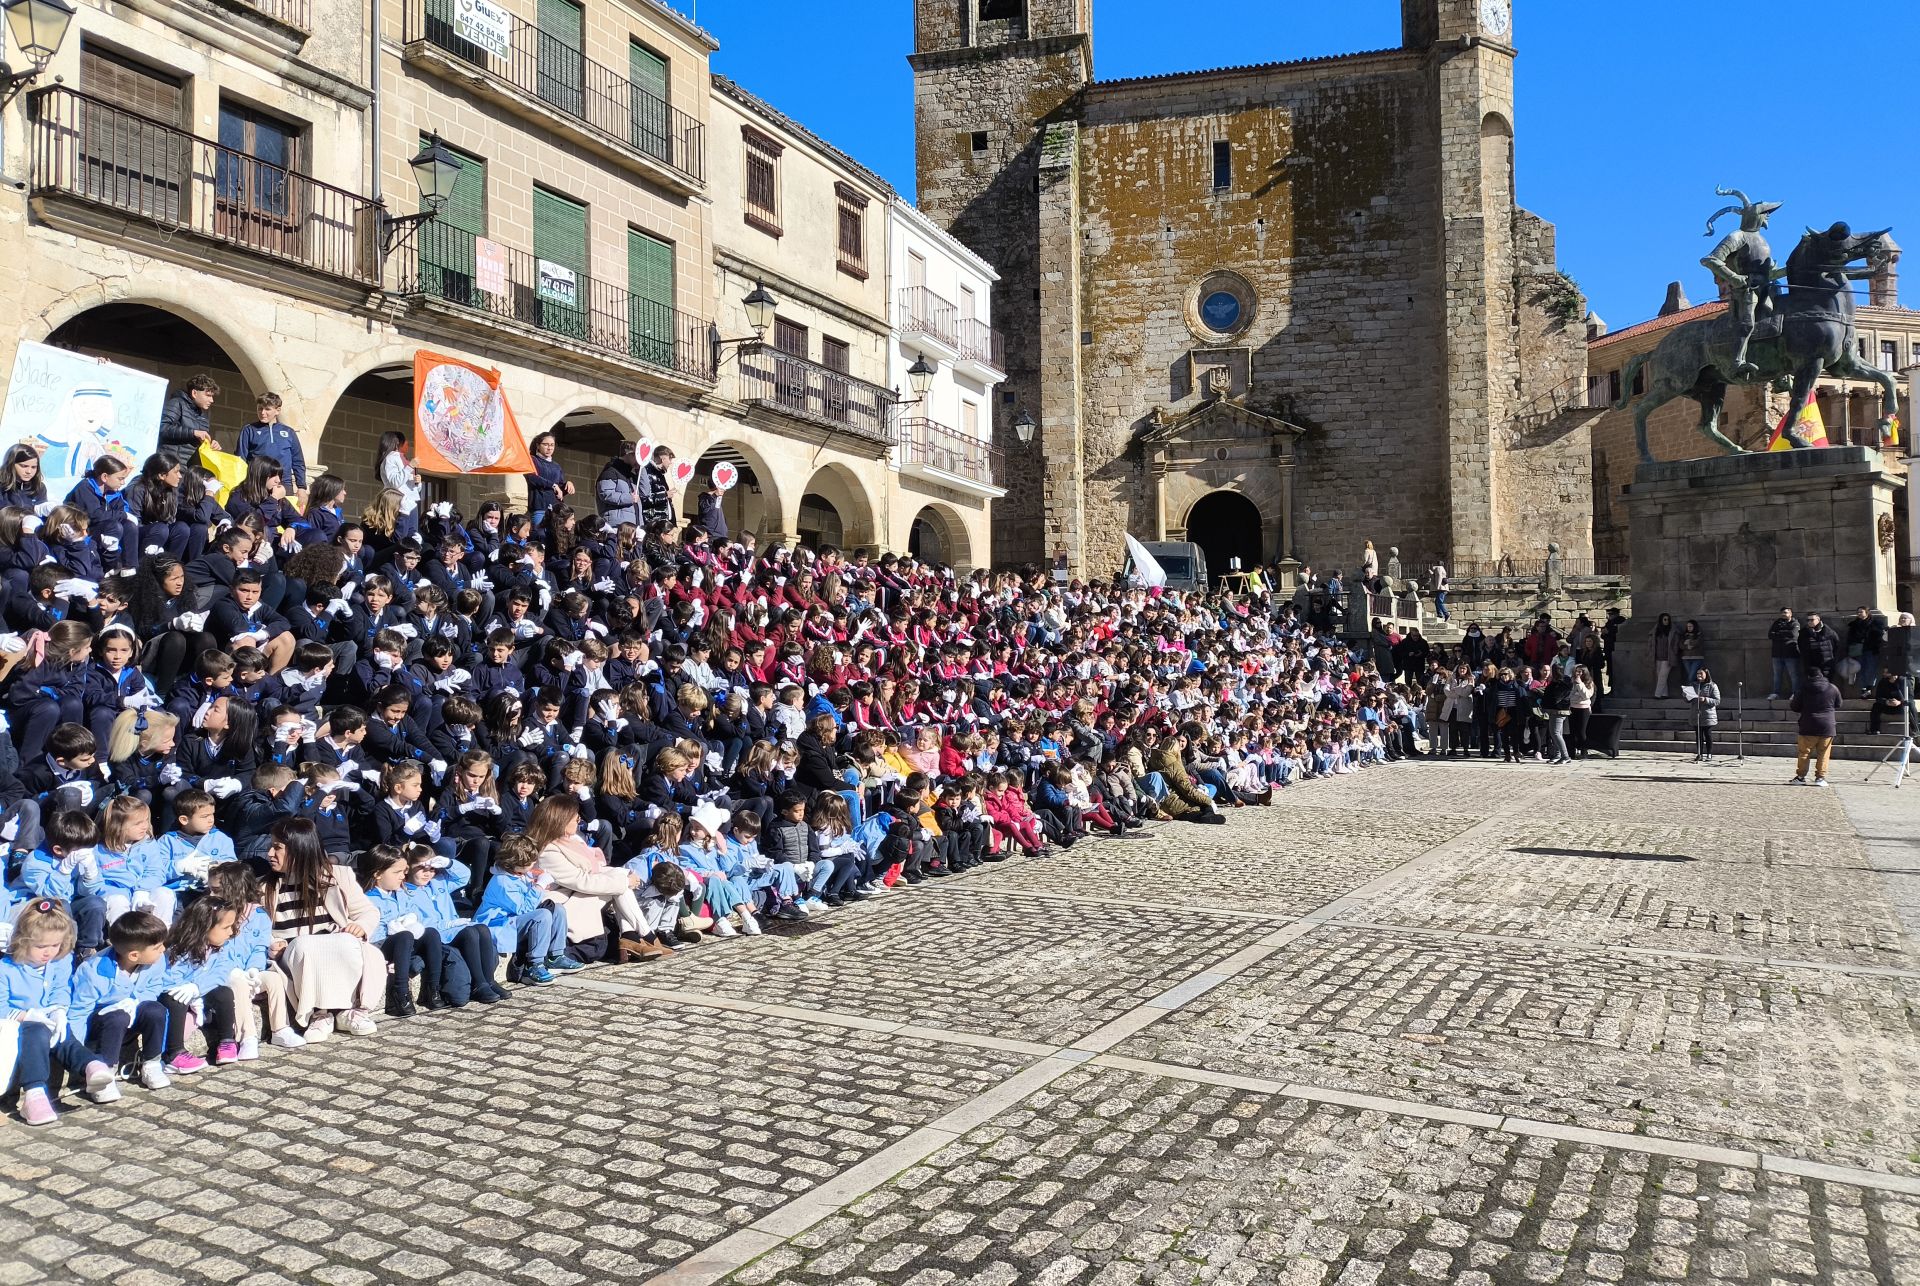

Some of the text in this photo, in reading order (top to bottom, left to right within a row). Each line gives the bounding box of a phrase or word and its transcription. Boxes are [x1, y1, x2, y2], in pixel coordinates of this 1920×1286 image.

[460, 13, 474, 25] 647
[475, 21, 485, 32] 42
[496, 33, 505, 43] 86
[461, 23, 504, 54] VENDE
[541, 287, 573, 304] ALQUILA
[15, 355, 62, 391] Madre
